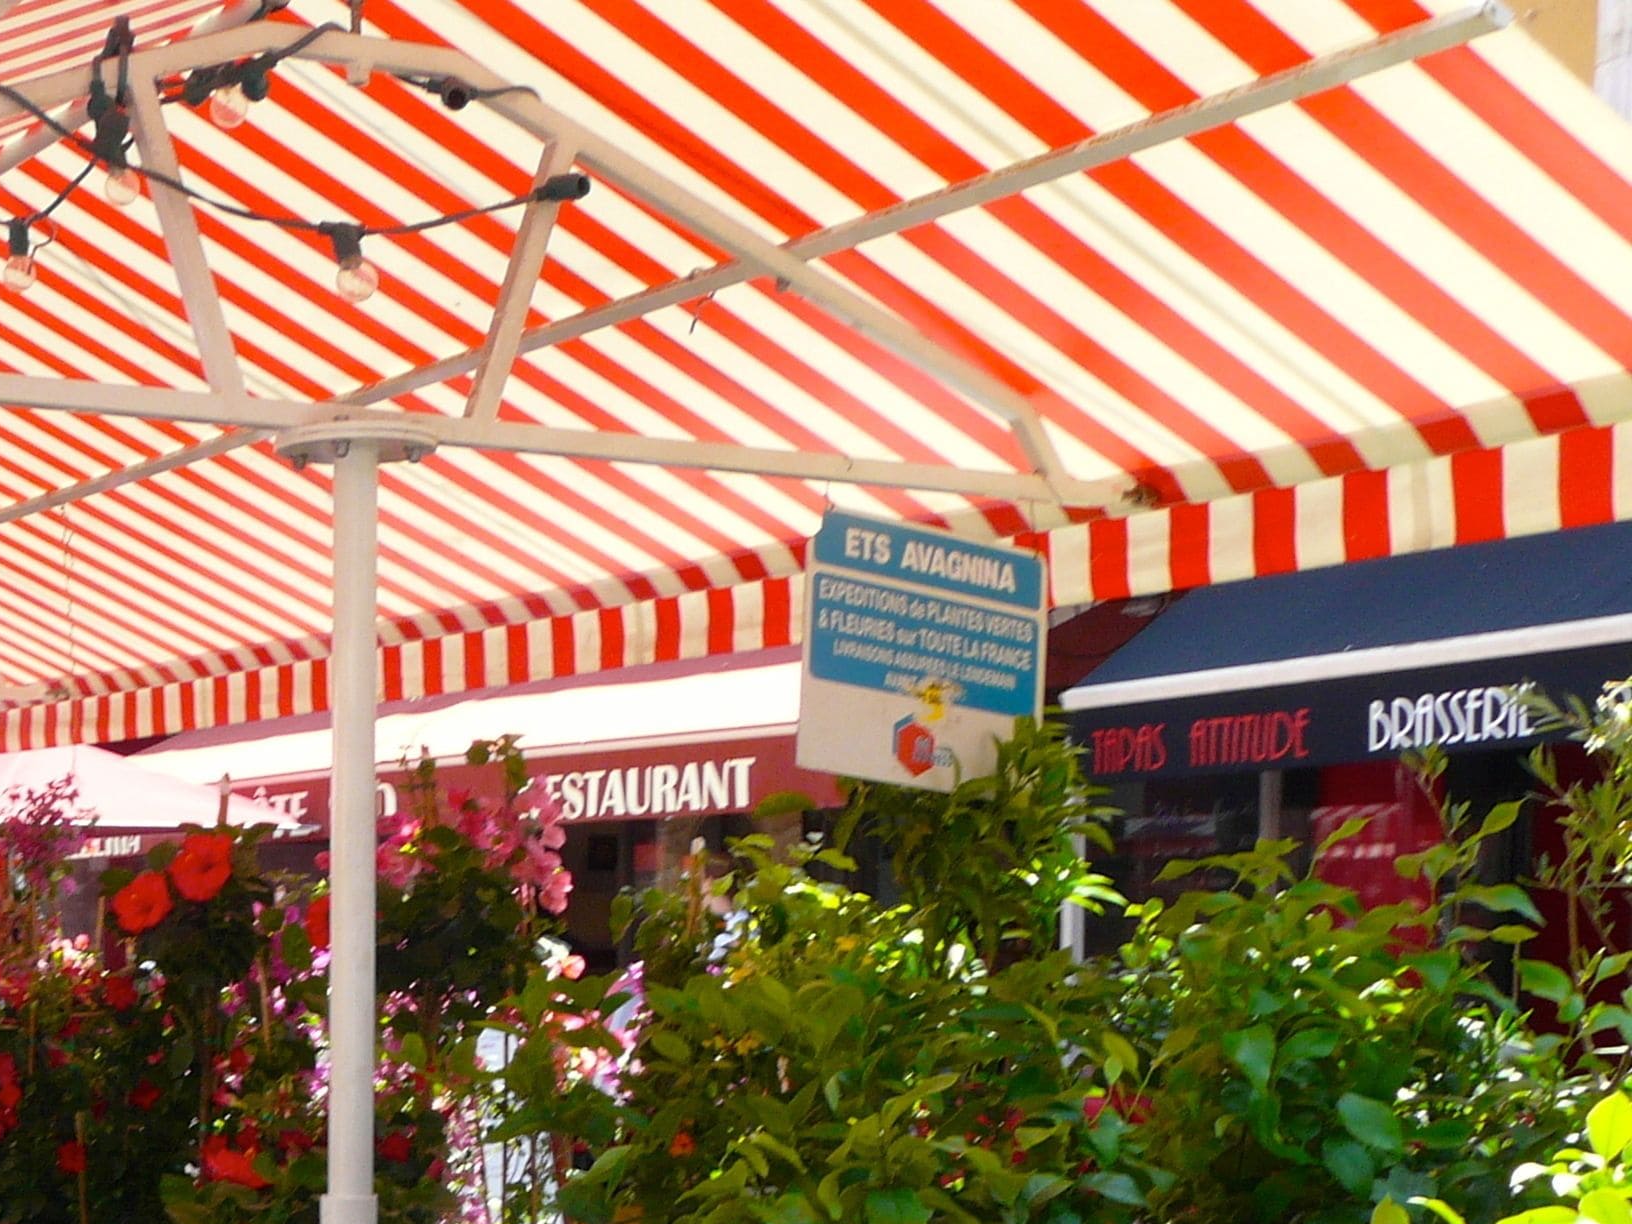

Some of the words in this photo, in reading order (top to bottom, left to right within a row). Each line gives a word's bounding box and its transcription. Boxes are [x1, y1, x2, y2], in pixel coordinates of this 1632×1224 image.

[845, 527, 892, 564] ETS
[900, 541, 1016, 594] AVAGNINA
[920, 628, 963, 657] TOUTE
[1090, 722, 1167, 774] TAPAS
[1189, 708, 1311, 767] ATTITUDE
[518, 757, 756, 820] ESTAURANT
